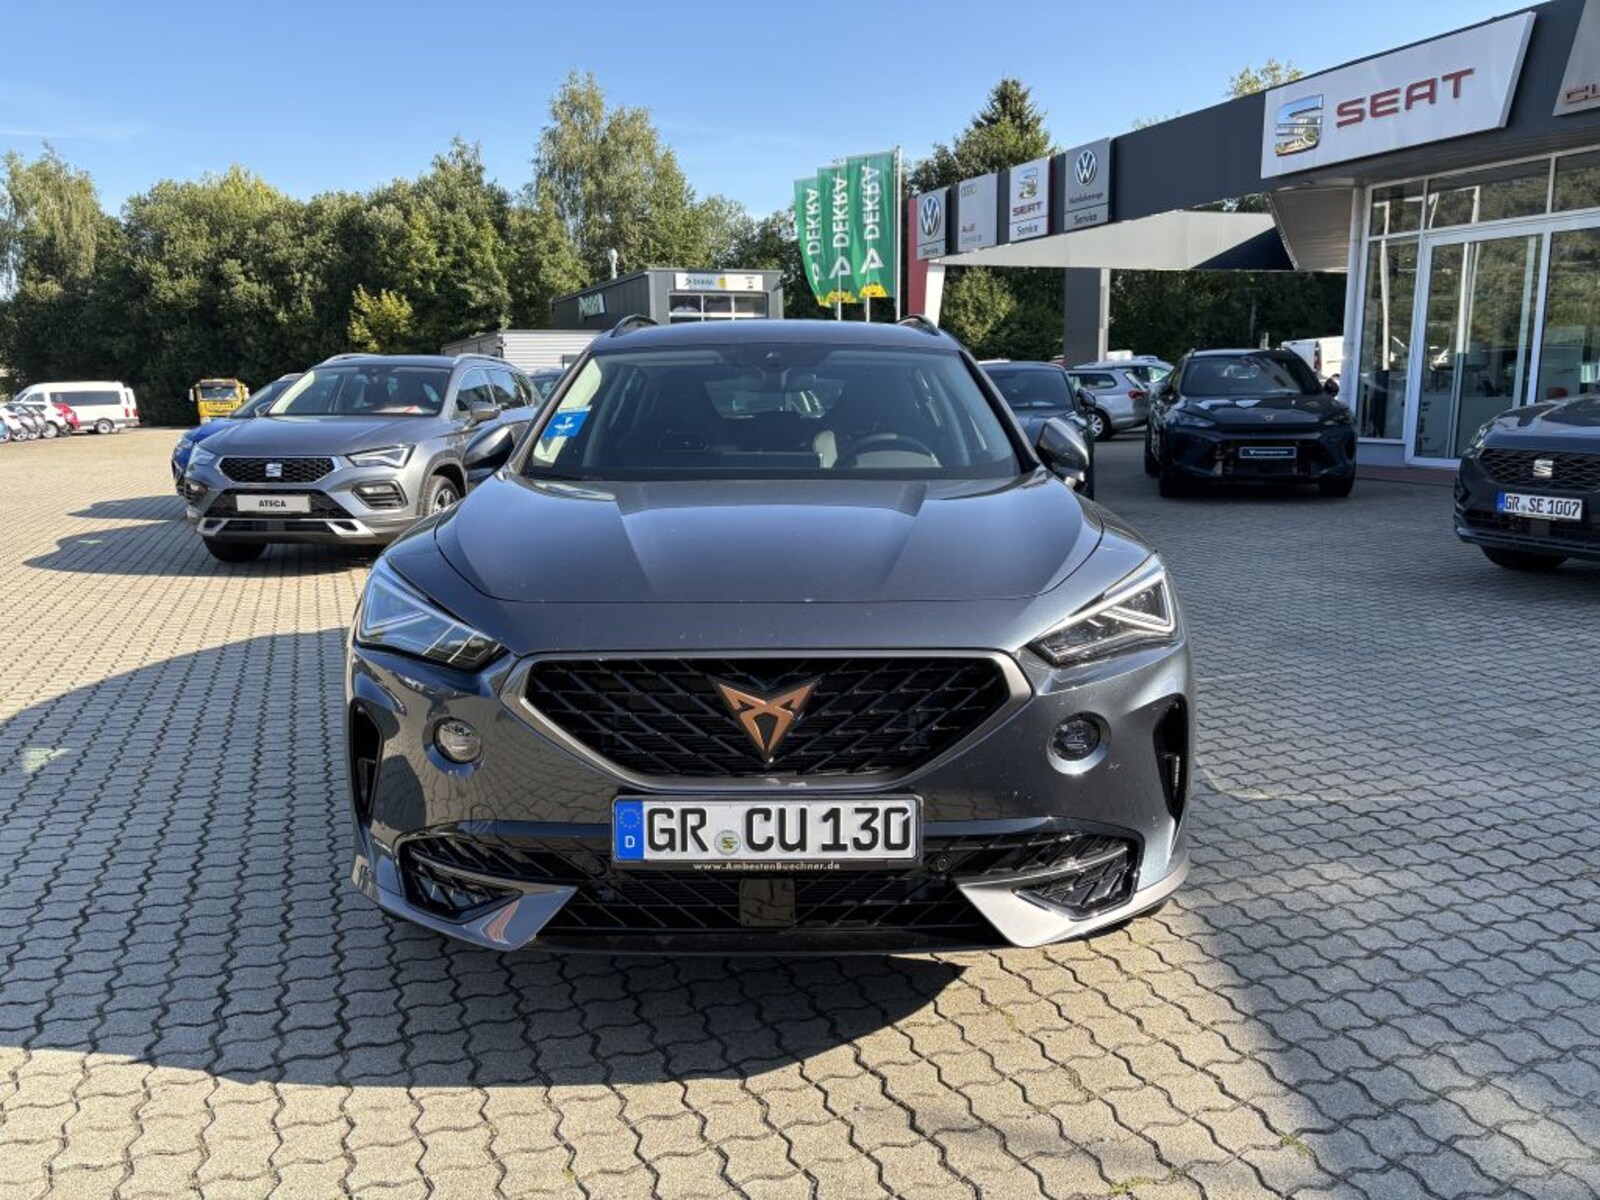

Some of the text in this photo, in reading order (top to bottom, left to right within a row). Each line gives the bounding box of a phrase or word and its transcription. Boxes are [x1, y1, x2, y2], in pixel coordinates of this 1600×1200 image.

[1336, 67, 1475, 128] SEAT
[806, 188, 821, 256] DEKRA
[833, 176, 849, 248] DEKRA
[862, 165, 880, 240] DEKRA
[1012, 201, 1043, 217] SEAT
[1505, 495, 1520, 511] GR
[1528, 498, 1545, 513] SE
[1547, 500, 1580, 516] 1007
[647, 807, 912, 853] GR CU 130
[693, 861, 841, 872] www.AmbestenBuechner.de
